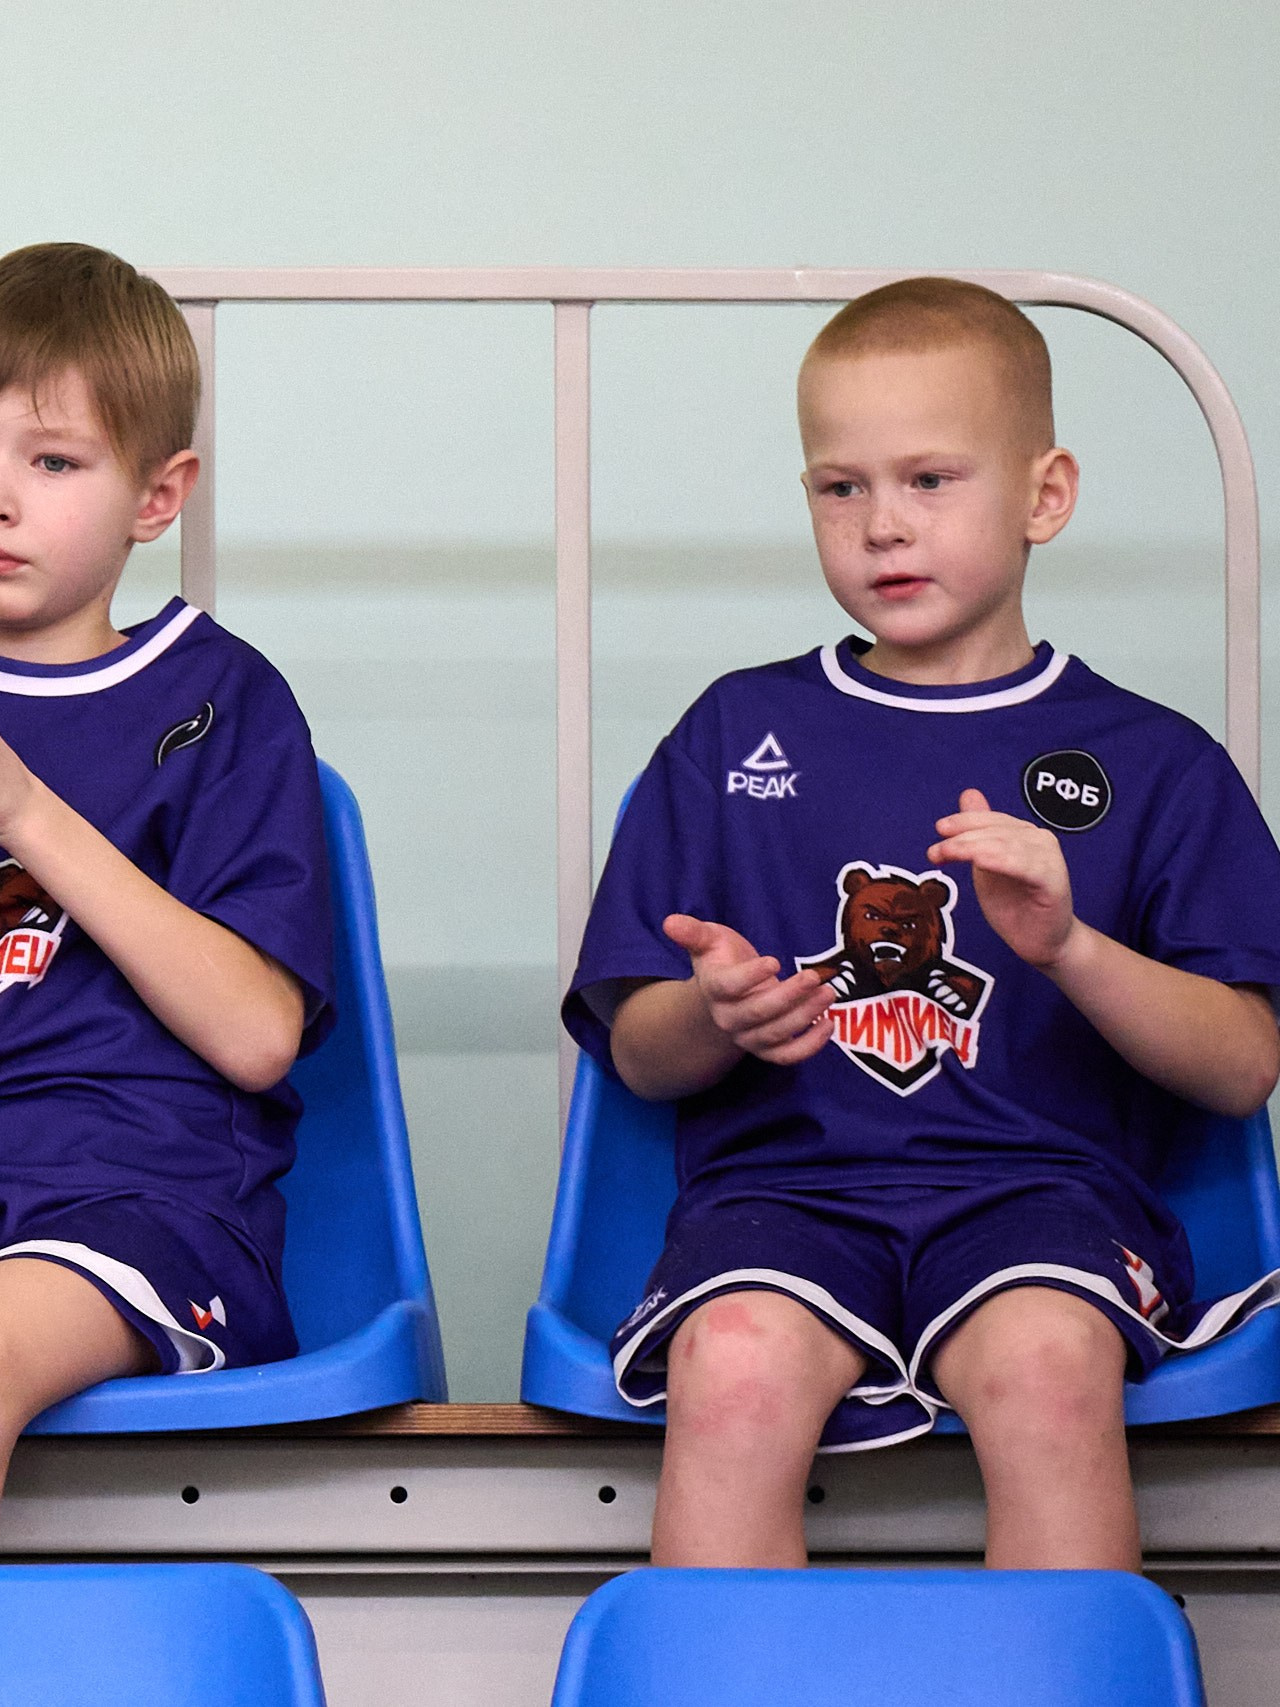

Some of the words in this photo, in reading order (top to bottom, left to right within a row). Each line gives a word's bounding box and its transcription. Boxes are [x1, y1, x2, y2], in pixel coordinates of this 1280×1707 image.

[727, 770, 801, 799] PEAK
[1036, 771, 1100, 807] РФБ
[828, 996, 972, 1063] ЛИМПИЕЦ
